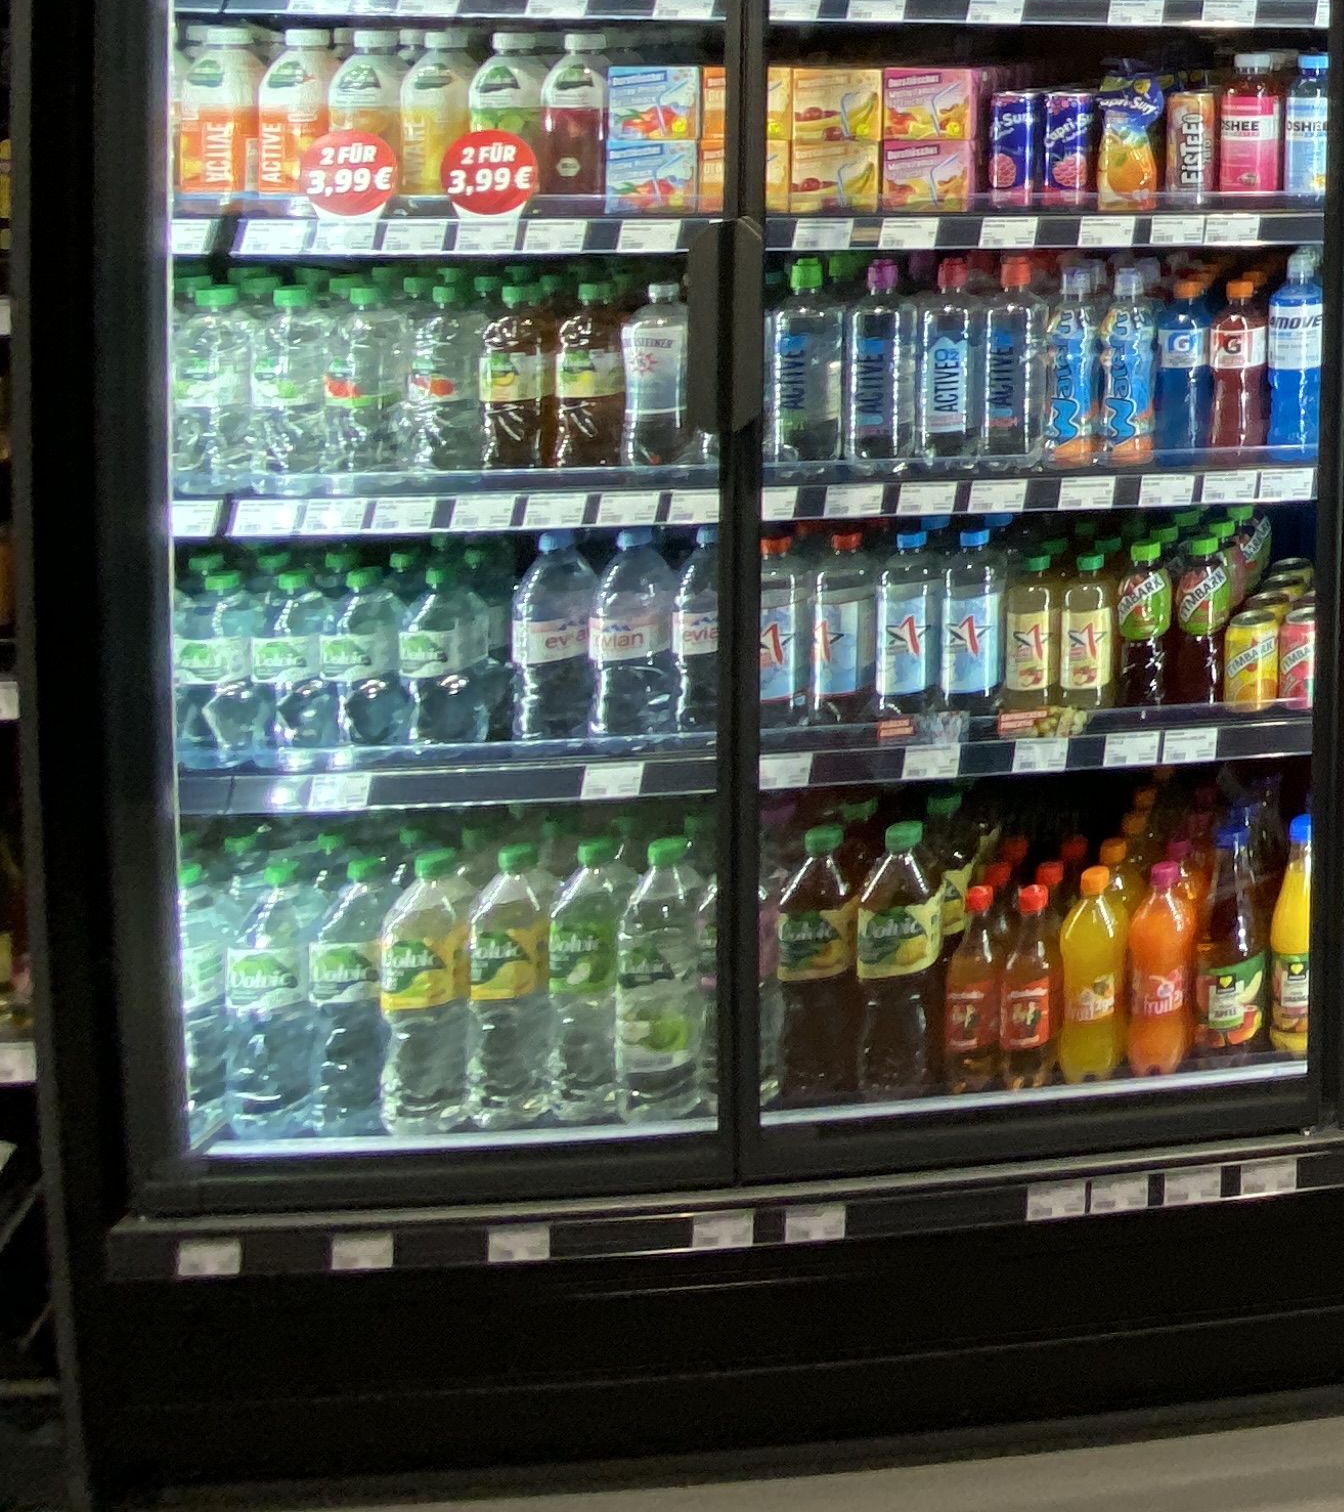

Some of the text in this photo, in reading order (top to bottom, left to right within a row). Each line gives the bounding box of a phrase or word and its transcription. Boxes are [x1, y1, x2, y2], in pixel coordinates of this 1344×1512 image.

[261, 122, 282, 184] ACTIVE
[319, 142, 378, 166] 2 FÜR
[460, 142, 517, 165] 2 FÜR
[306, 168, 371, 198] 3,99
[447, 167, 512, 196] 3,99
[1172, 335, 1191, 352] G
[1223, 335, 1243, 355] G
[934, 360, 959, 413] ACTIVE
